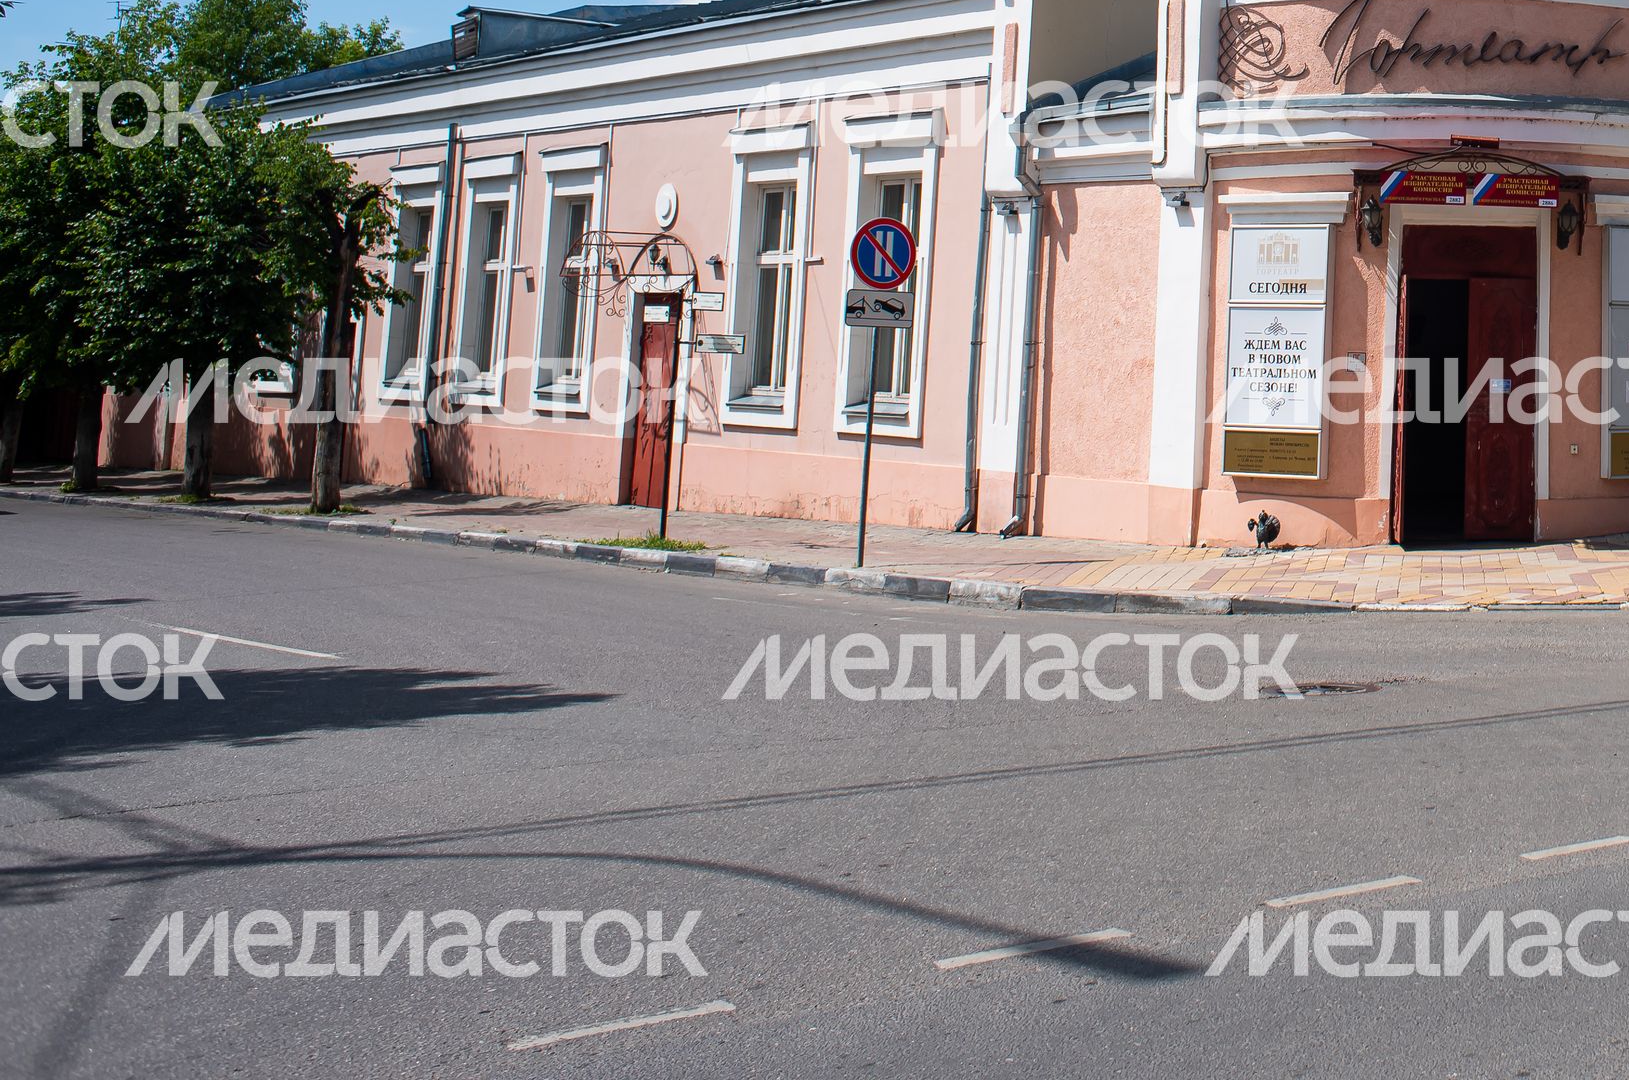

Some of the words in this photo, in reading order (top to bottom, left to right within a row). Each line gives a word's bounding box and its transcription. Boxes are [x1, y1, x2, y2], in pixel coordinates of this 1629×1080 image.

[1403, 180, 1463, 188] ИЗБИРАТЕЛЬНАЯ
[1496, 183, 1556, 191] ИЗБИРАТЕЛЬНАЯ
[1503, 177, 1549, 185] УЧАСТКОВАЯ
[1248, 282, 1308, 296] СЕГОДНЯ
[1243, 339, 1281, 351] ЖДЕМ
[1284, 340, 1308, 351] ВАС
[1248, 353, 1256, 364] В
[1259, 353, 1302, 365] НОВОМ
[1231, 366, 1318, 380] ТЕАТРАЛЬНОМ
[1249, 381, 1298, 393] СЕЗОНЕ!
